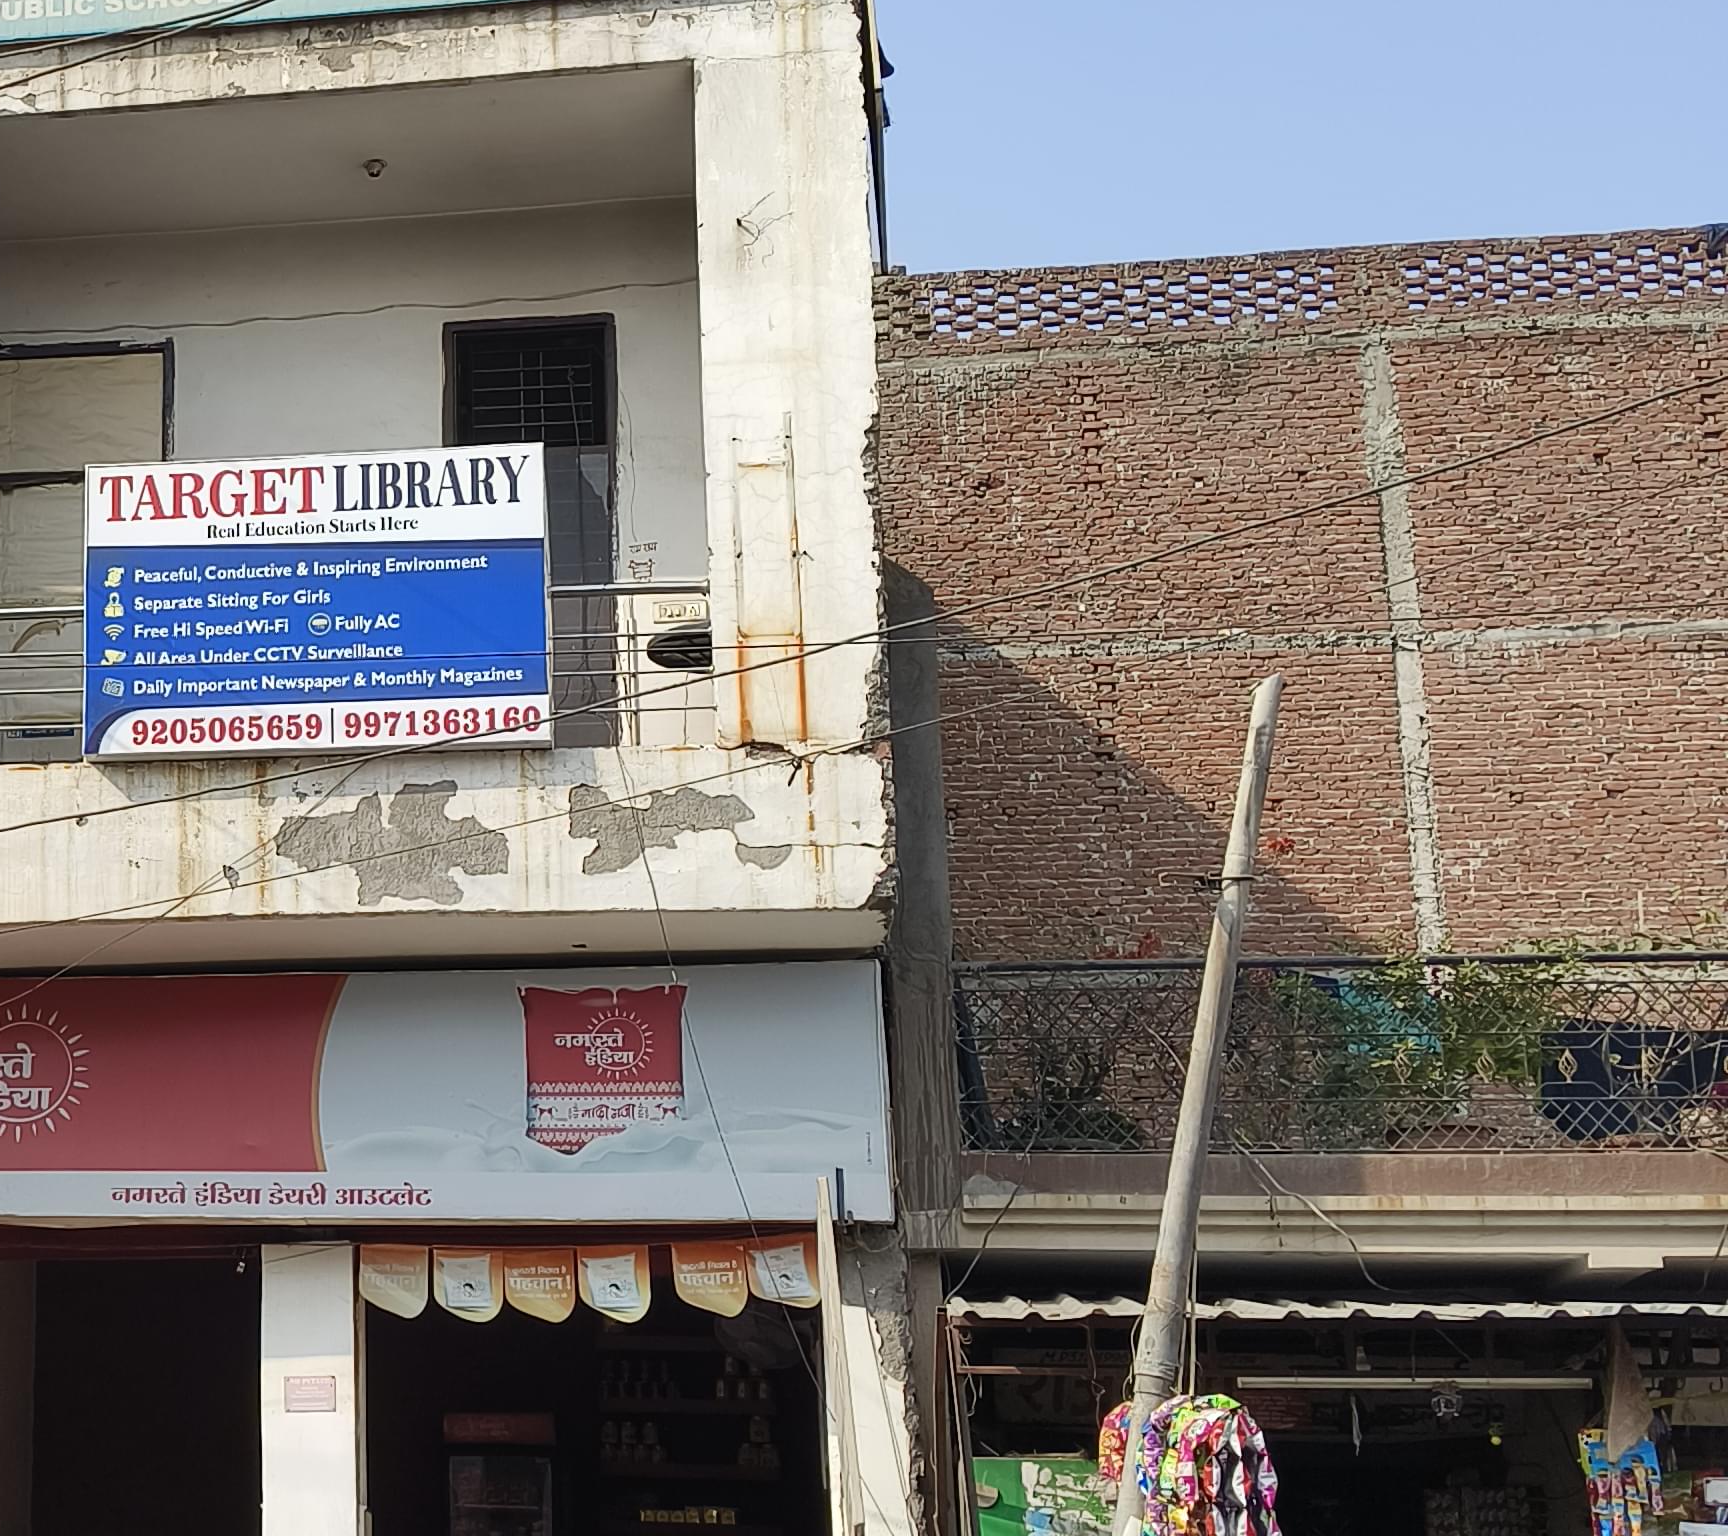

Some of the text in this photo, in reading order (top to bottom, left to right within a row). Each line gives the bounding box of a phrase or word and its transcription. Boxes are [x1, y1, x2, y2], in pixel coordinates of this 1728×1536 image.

[99, 455, 529, 522] TARGET LIBRARY
[207, 516, 419, 540] Real Education Starts Here
[134, 589, 331, 613] Separate Sitting For Girls
[335, 614, 400, 634] Fully AC
[131, 705, 541, 746] 9205065659 9971363160
[554, 1028, 624, 1048] नमस्ते
[112, 1182, 432, 1206] नमस्ते इंडिया डेयरी आउटलेट
